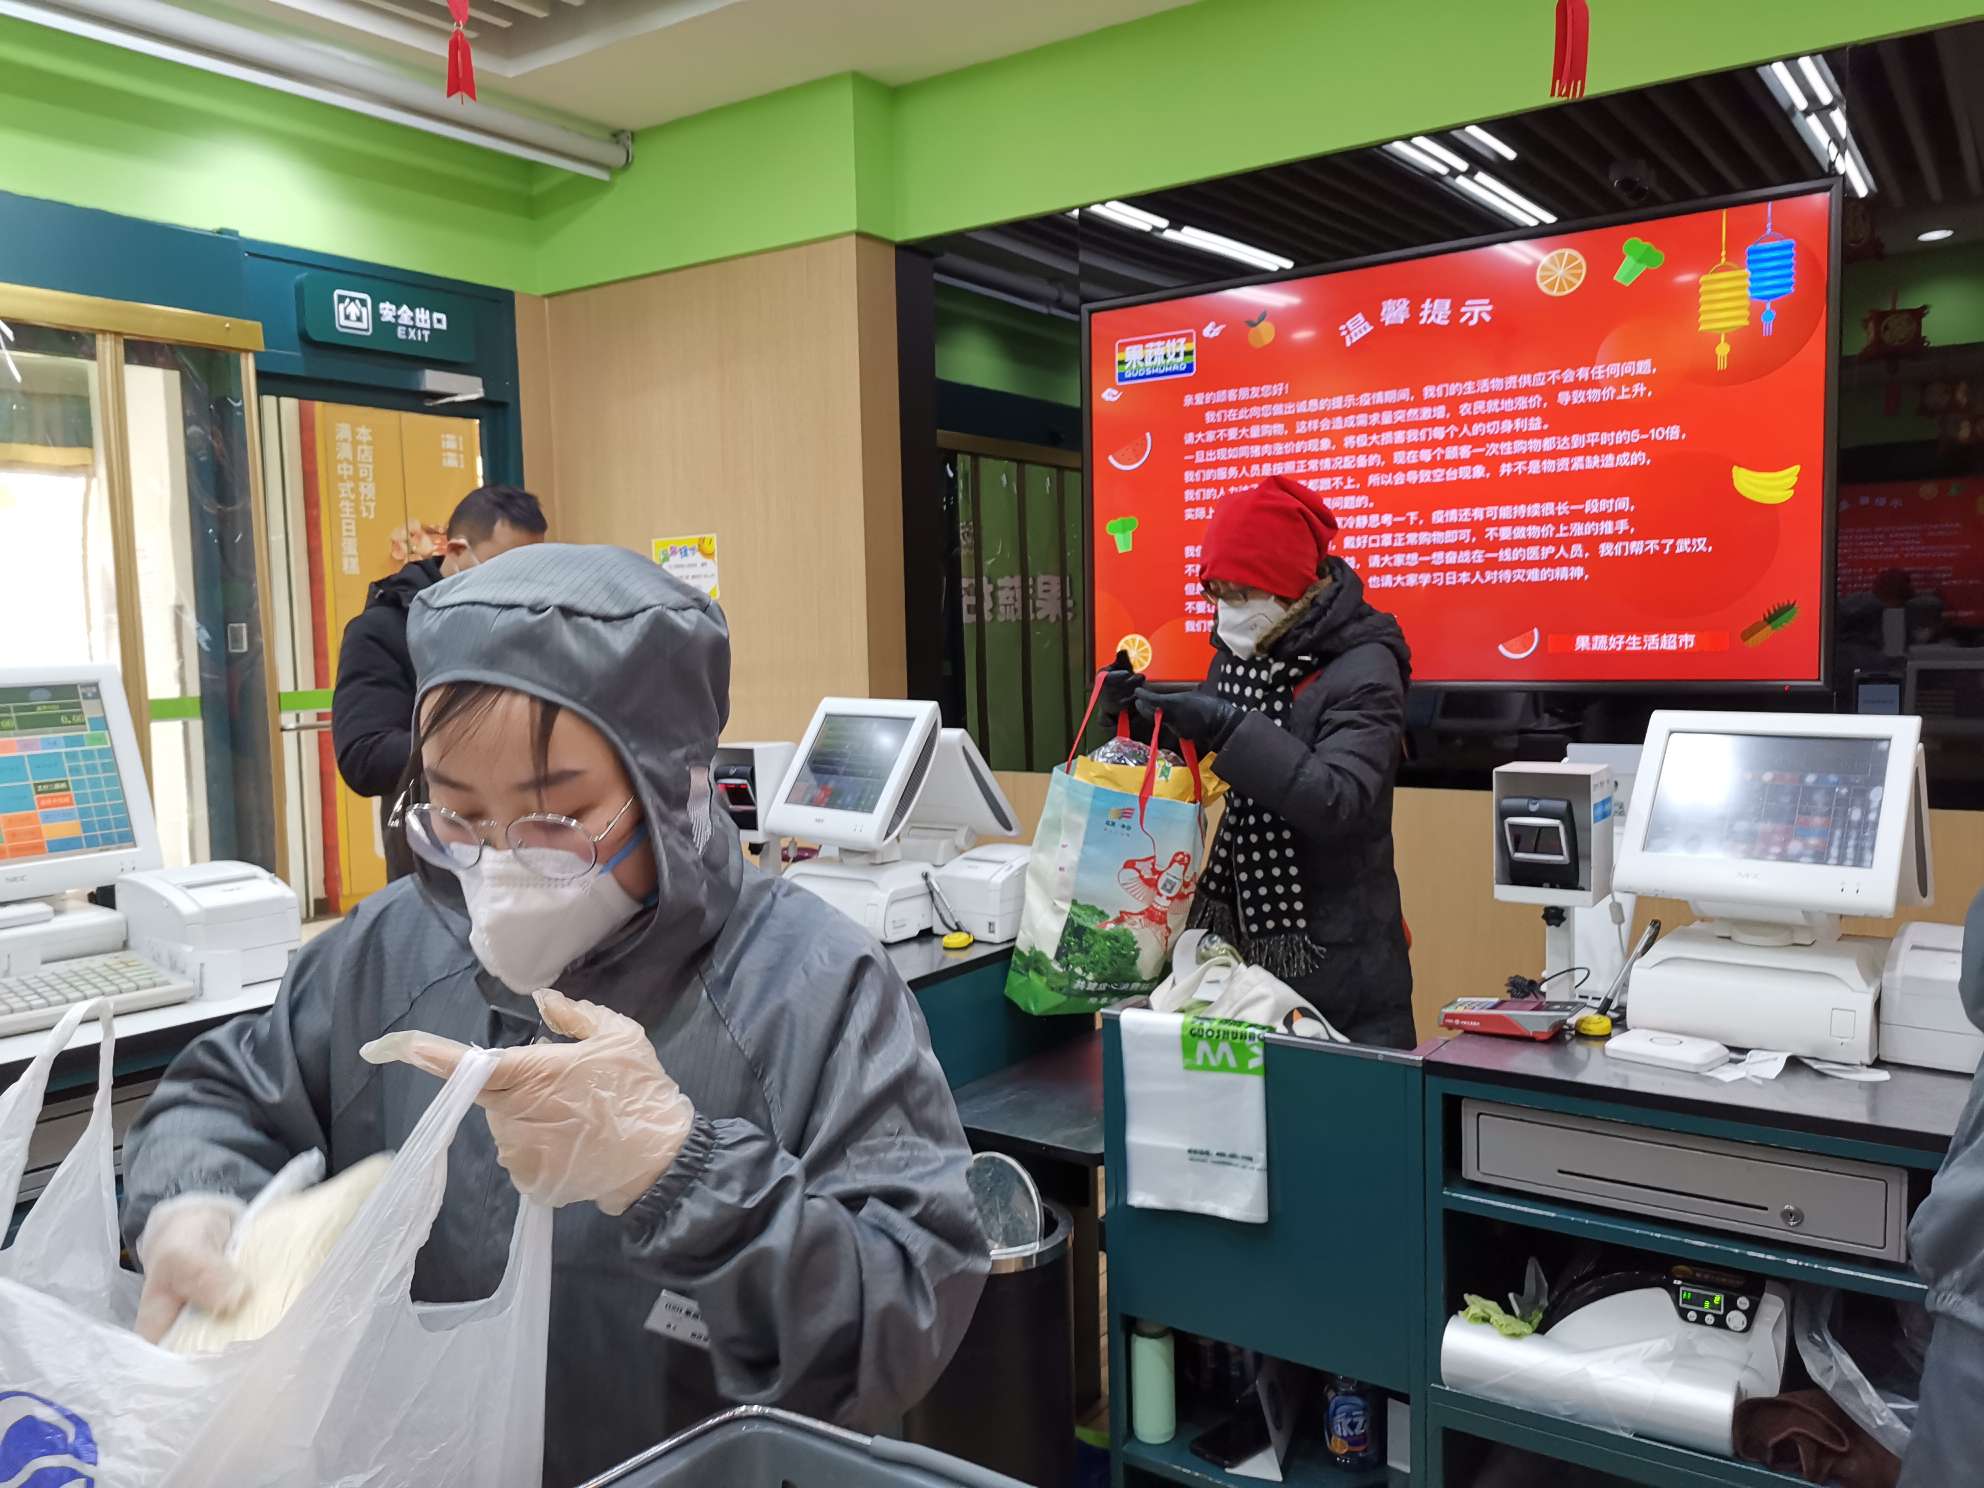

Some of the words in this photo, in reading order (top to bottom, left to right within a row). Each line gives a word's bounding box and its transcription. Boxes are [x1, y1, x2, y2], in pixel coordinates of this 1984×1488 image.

[379, 301, 447, 330] 安全出口
[1340, 298, 1493, 347] 温馨提示
[397, 326, 430, 343] EXIT
[1125, 337, 1186, 369] 果蔬好
[1124, 362, 1187, 378] GUOSHUHAO
[355, 425, 376, 519] 本店可预订
[1574, 633, 1696, 651] 果蔬好生活超市
